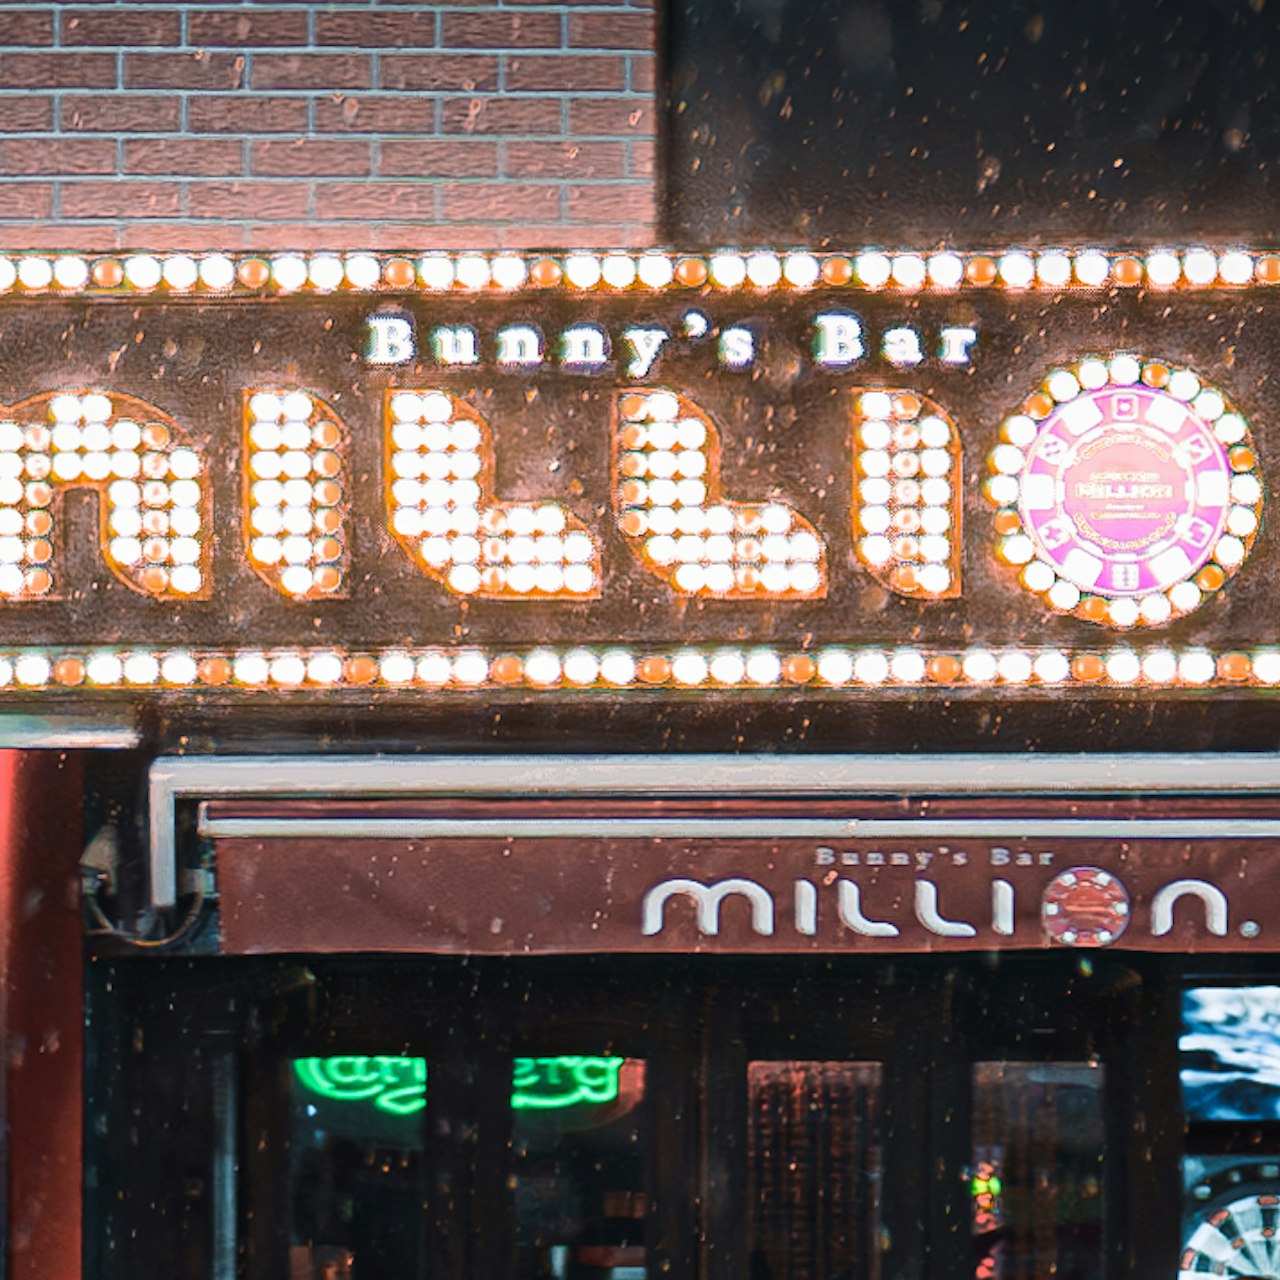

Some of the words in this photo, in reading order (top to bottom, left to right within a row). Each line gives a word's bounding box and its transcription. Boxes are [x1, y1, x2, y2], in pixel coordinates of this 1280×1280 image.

[366, 312, 756, 378] Bunny's
[816, 314, 977, 366] Bar
[990, 847, 1054, 866] Bar
